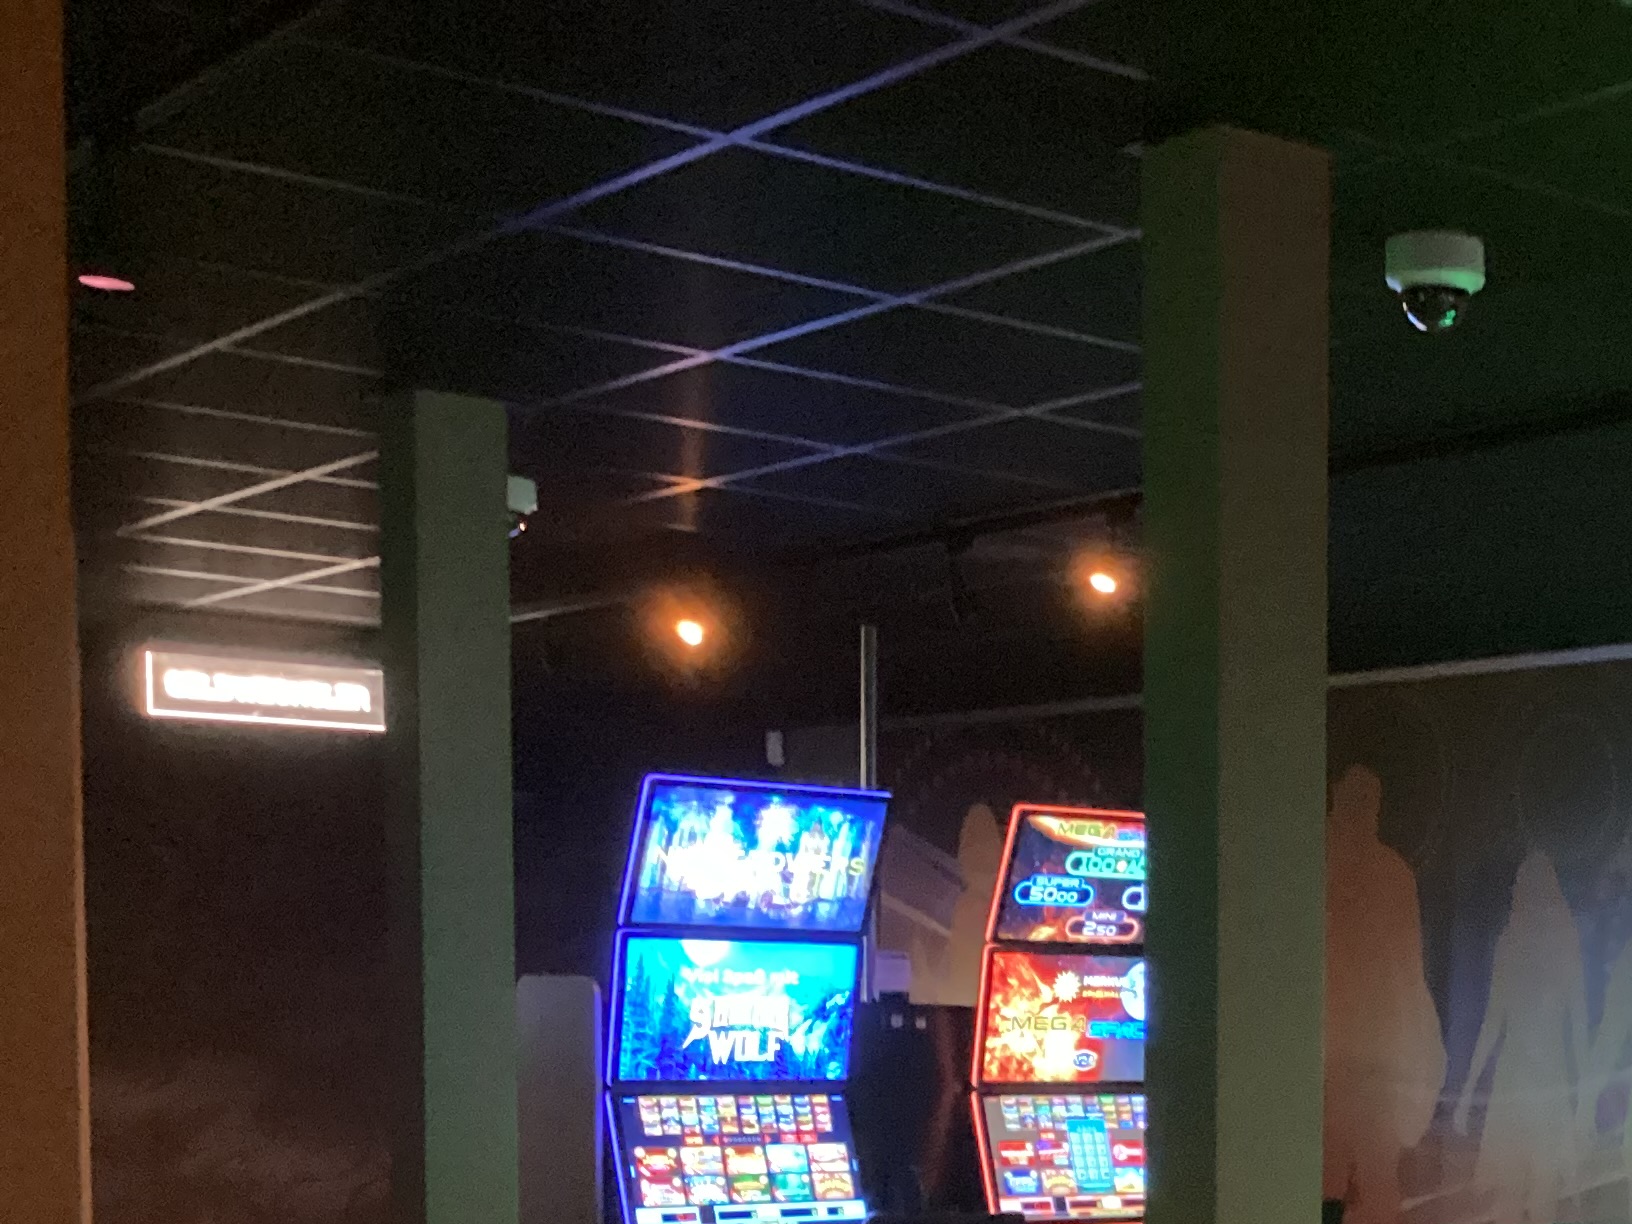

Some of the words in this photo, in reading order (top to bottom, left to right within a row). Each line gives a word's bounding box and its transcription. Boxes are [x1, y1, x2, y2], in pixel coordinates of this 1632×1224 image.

[1036, 877, 1080, 888] SUPER
[1092, 911, 1117, 921] MINI
[1082, 921, 1117, 936] 250
[1011, 1015, 1087, 1032] MEGA
[708, 1030, 781, 1065] WOLF
